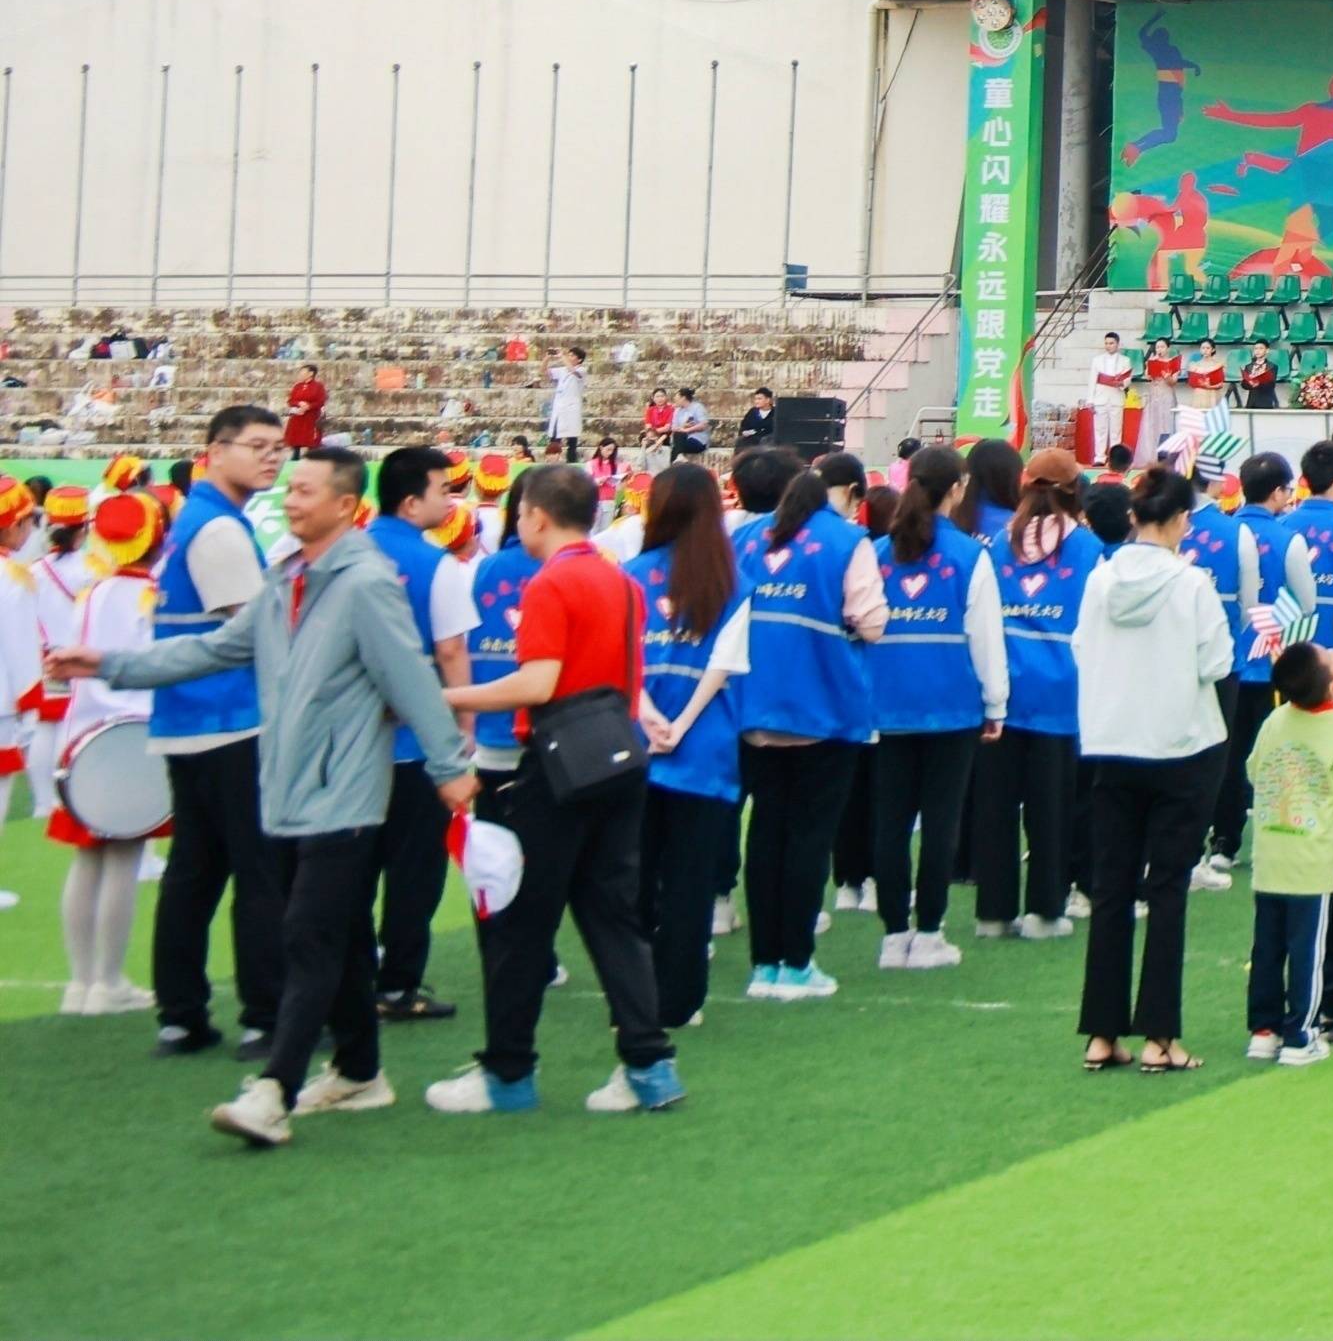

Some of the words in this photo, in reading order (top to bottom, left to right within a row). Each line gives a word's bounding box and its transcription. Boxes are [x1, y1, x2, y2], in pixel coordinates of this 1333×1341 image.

[972, 77, 1014, 419] 童心闪耀永远跟党走
